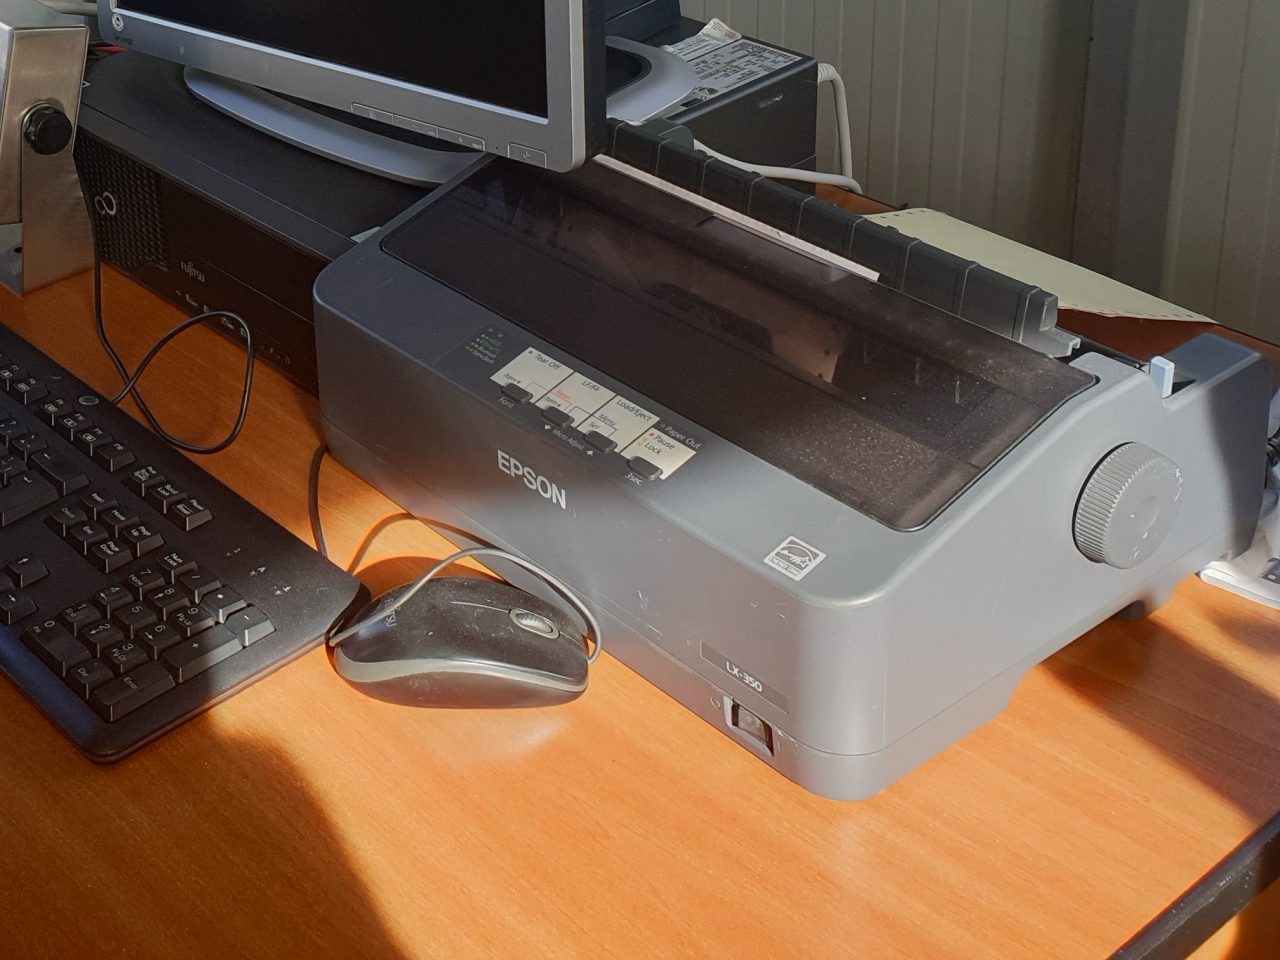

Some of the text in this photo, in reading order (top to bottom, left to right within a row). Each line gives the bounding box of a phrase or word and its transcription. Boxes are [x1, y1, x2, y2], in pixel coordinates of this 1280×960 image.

[535, 353, 550, 365] Tear
[616, 400, 652, 423] Load/Eject
[654, 433, 676, 450] Pause
[664, 426, 702, 450] Paper Out
[644, 442, 663, 456] Lock
[497, 449, 567, 511] EPSON
[625, 471, 644, 487] 3sec
[131, 605, 144, 613] 5
[187, 607, 199, 615] 9
[44, 620, 55, 628] 0
[154, 624, 166, 632] 6
[122, 643, 134, 651] 3
[725, 660, 763, 693] LX-350
